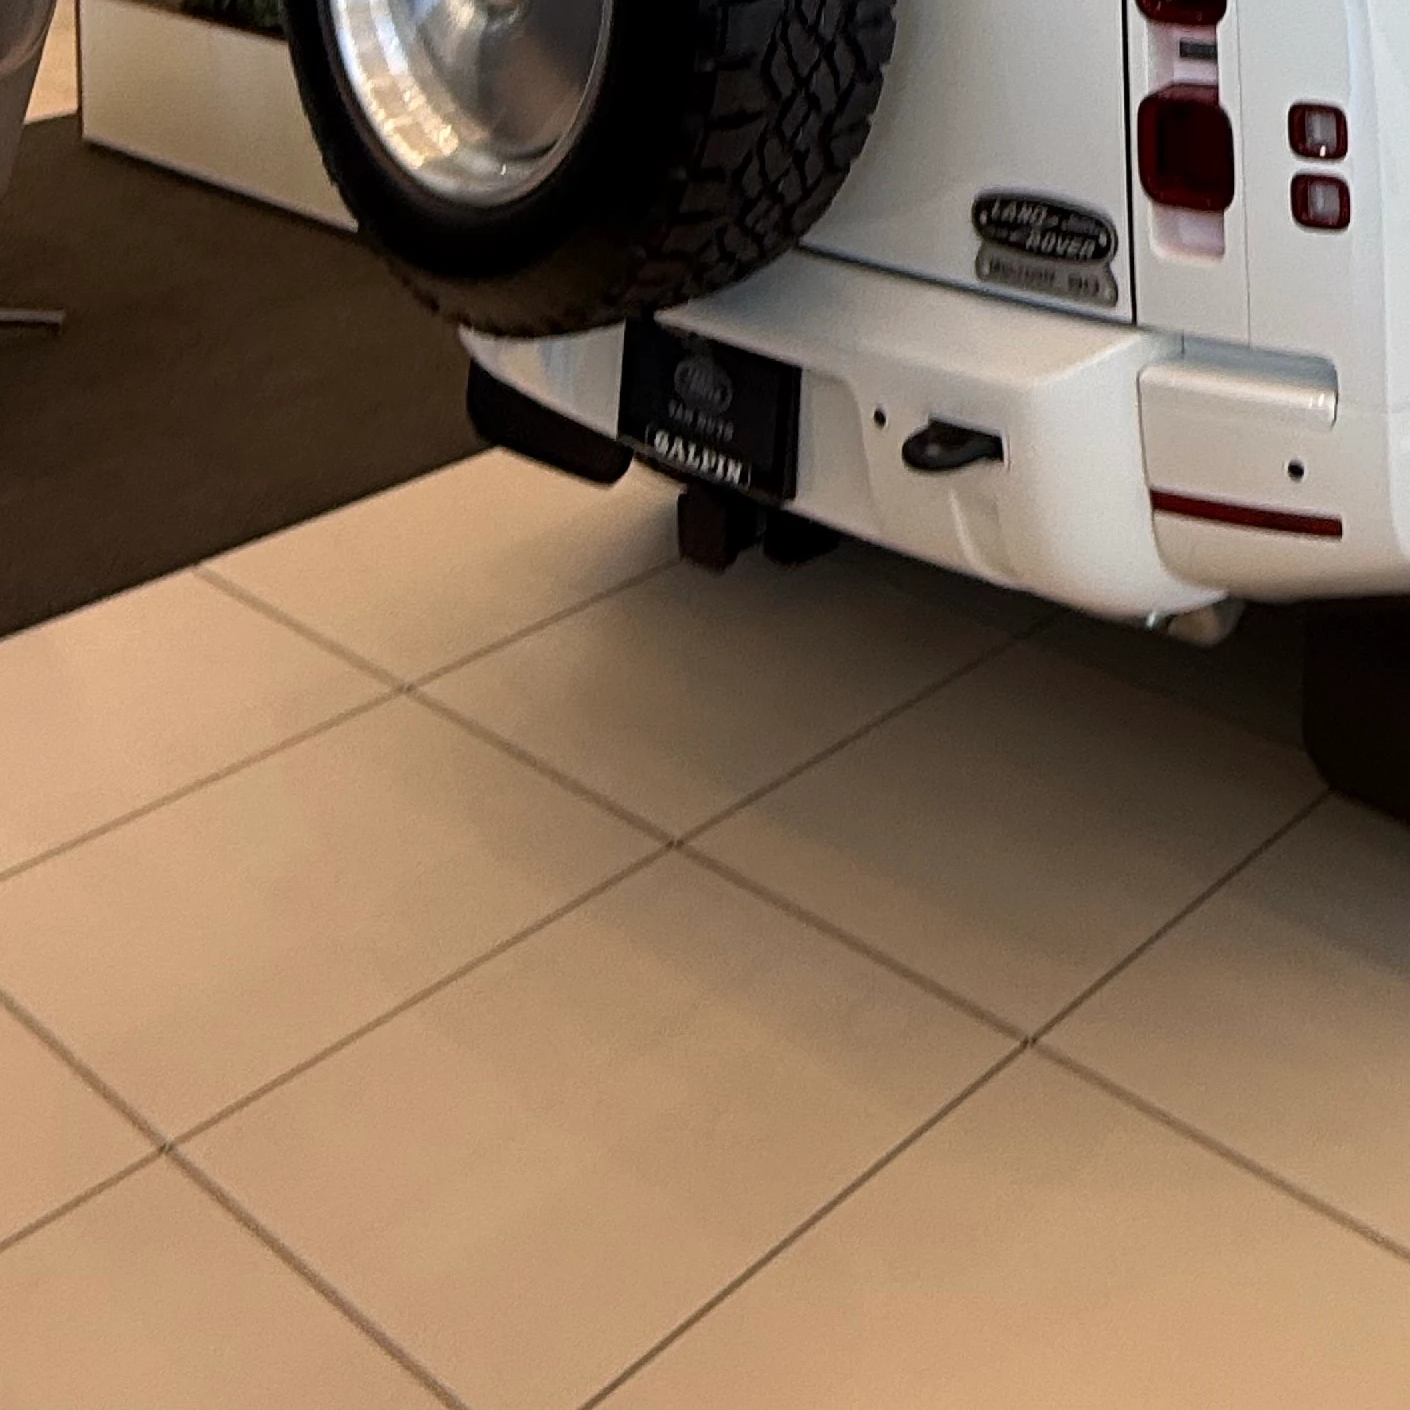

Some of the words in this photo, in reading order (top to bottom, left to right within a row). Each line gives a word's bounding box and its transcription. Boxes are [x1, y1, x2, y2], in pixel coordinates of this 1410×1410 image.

[991, 197, 1049, 226] LAND
[1025, 228, 1097, 261] ROVER
[654, 429, 743, 485] GALPIN
